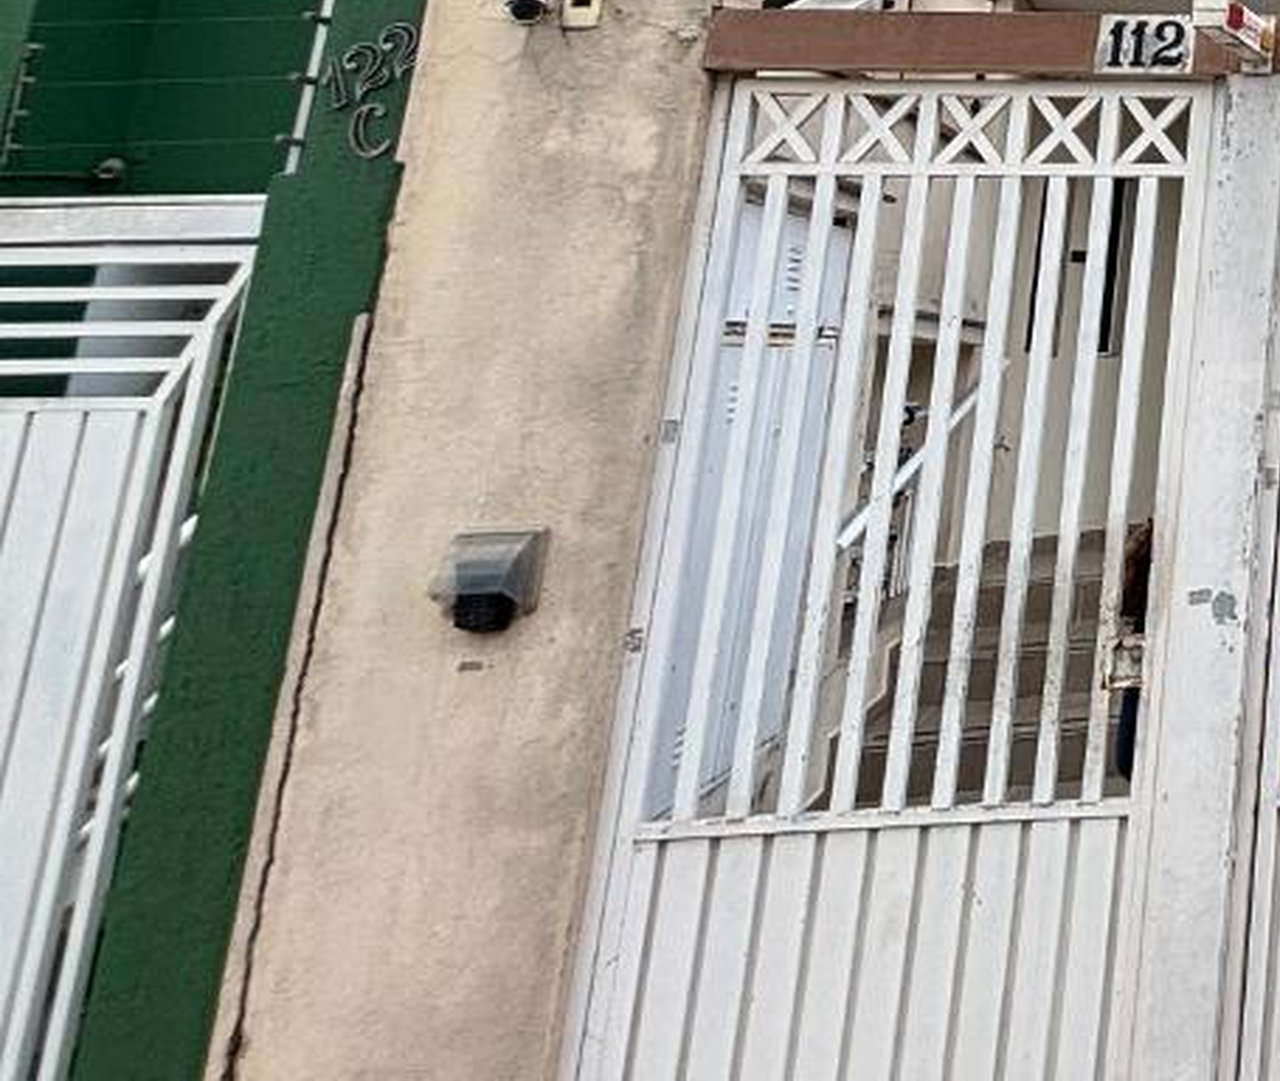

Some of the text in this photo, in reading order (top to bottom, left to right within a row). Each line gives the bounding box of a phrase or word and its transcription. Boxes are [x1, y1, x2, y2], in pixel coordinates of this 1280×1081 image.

[322, 21, 419, 110] 122
[1106, 20, 1186, 68] 112
[348, 102, 393, 158] C
